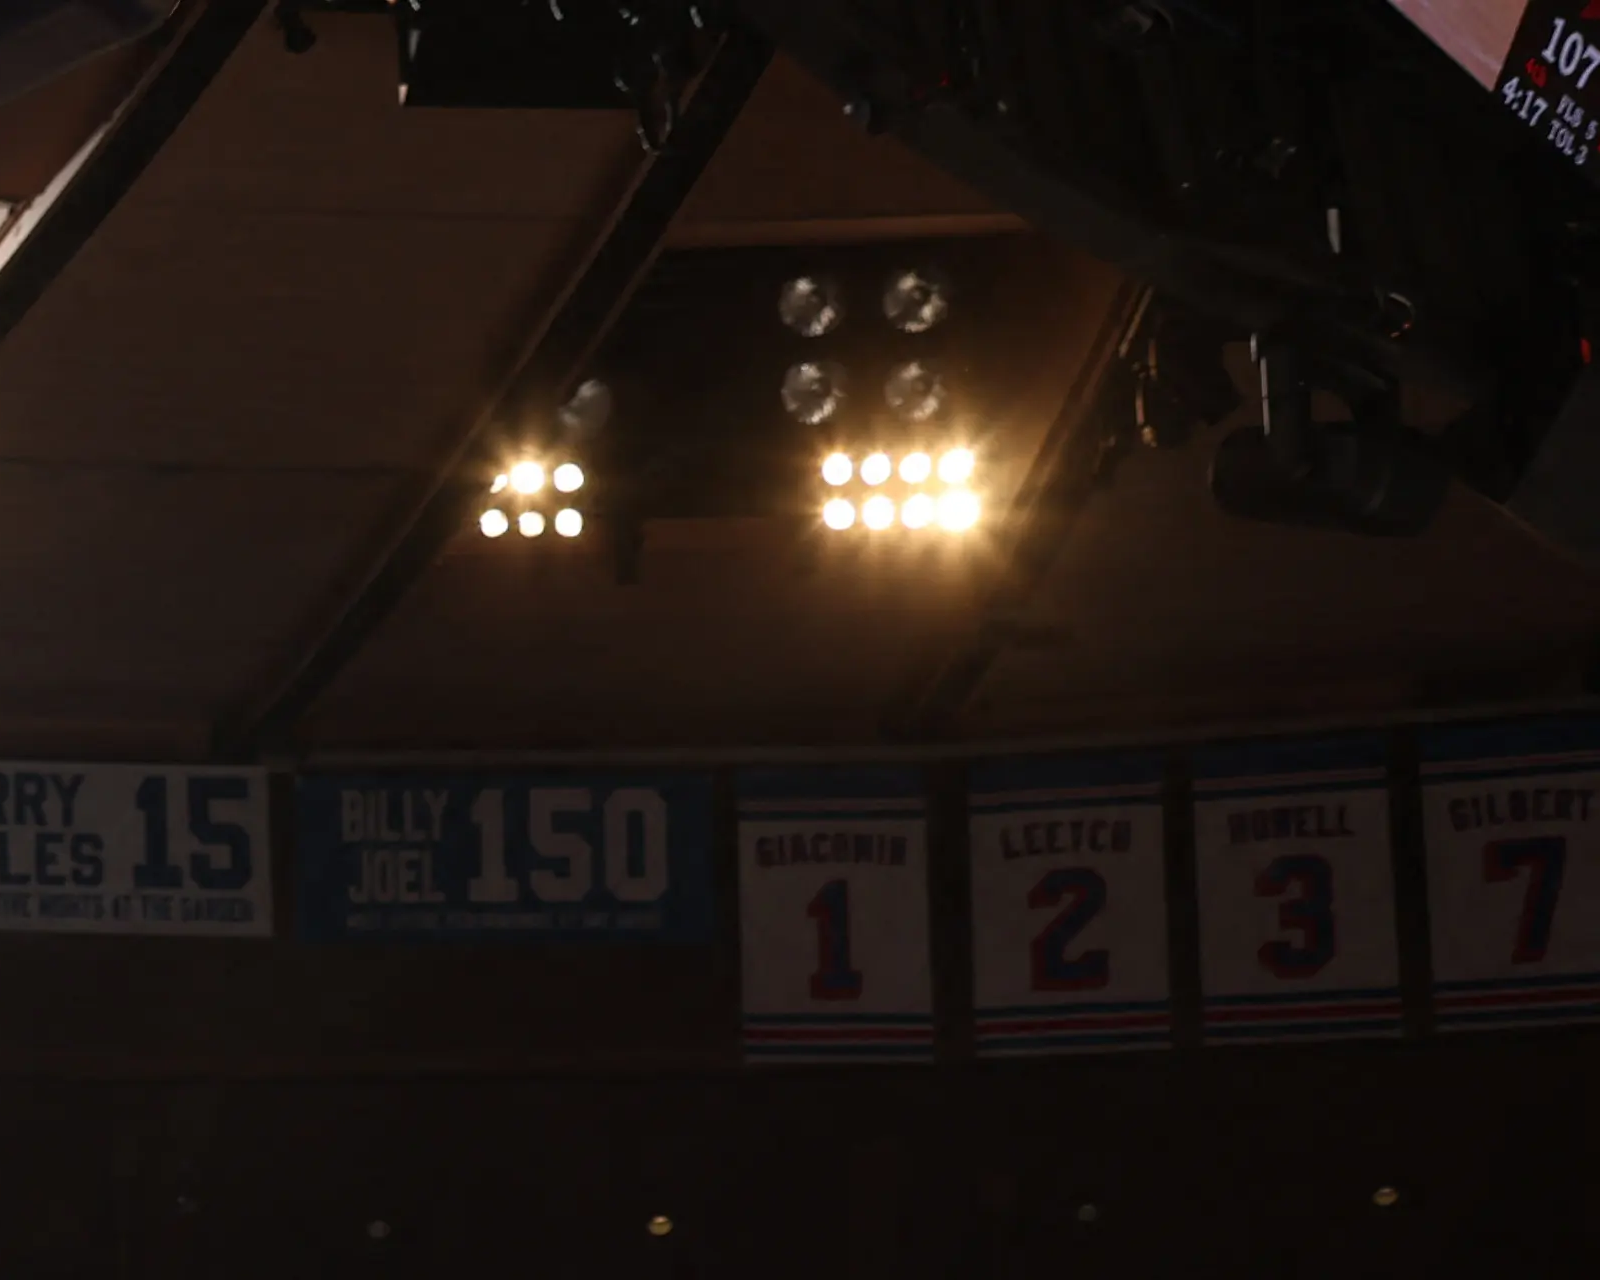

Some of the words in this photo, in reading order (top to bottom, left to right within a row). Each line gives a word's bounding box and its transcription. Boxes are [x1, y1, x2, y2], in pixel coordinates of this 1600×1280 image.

[1541, 17, 1600, 90] 107
[1502, 76, 1549, 127] 4:17
[1547, 118, 1577, 156] TOL
[133, 775, 252, 890] 15
[342, 787, 450, 843] BILLY
[467, 787, 668, 903] 150
[999, 819, 1132, 860] LEETCH
[1448, 787, 1597, 832] GILBERT
[347, 846, 446, 905] JOEL
[1483, 835, 1567, 965] 7
[807, 879, 863, 1001] 1
[1027, 867, 1109, 992] 2
[1255, 854, 1336, 980] 3
